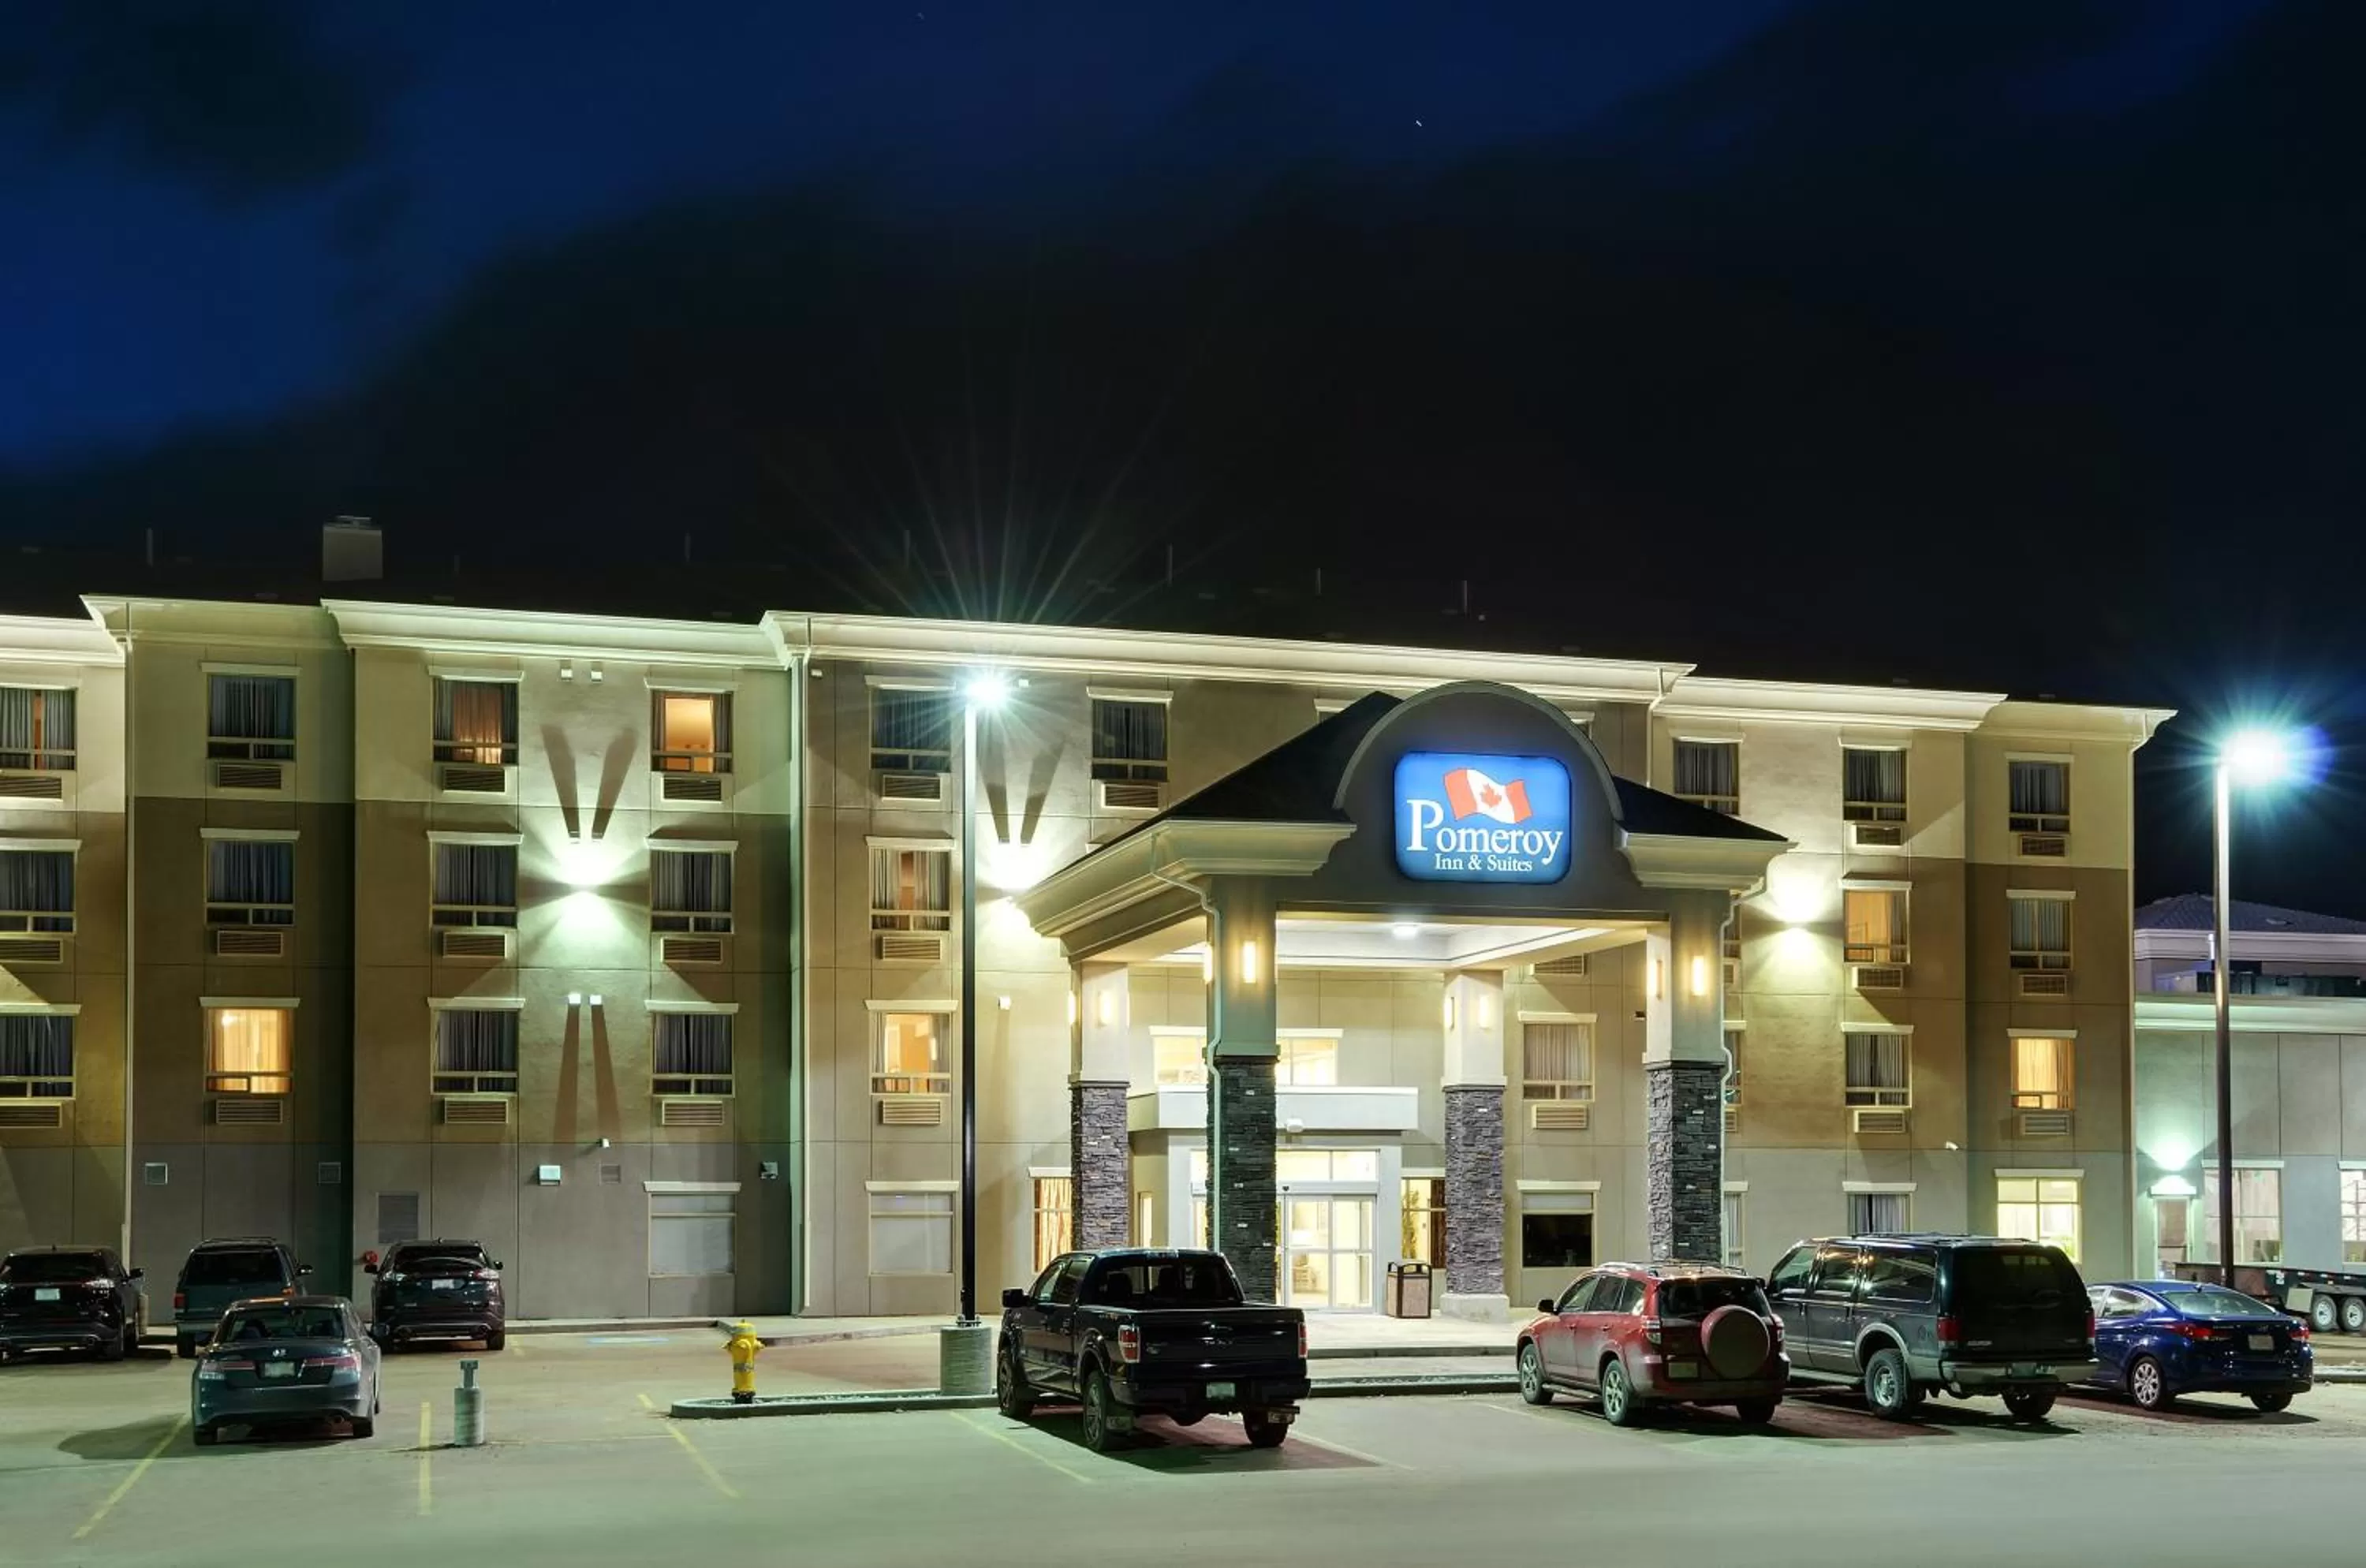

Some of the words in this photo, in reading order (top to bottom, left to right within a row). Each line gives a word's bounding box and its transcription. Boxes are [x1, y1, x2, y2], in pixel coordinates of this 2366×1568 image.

[1406, 799, 1563, 865] Pomeroy
[1434, 853, 1464, 870] Inn
[1467, 854, 1483, 871] &
[1487, 855, 1533, 872] Suites
